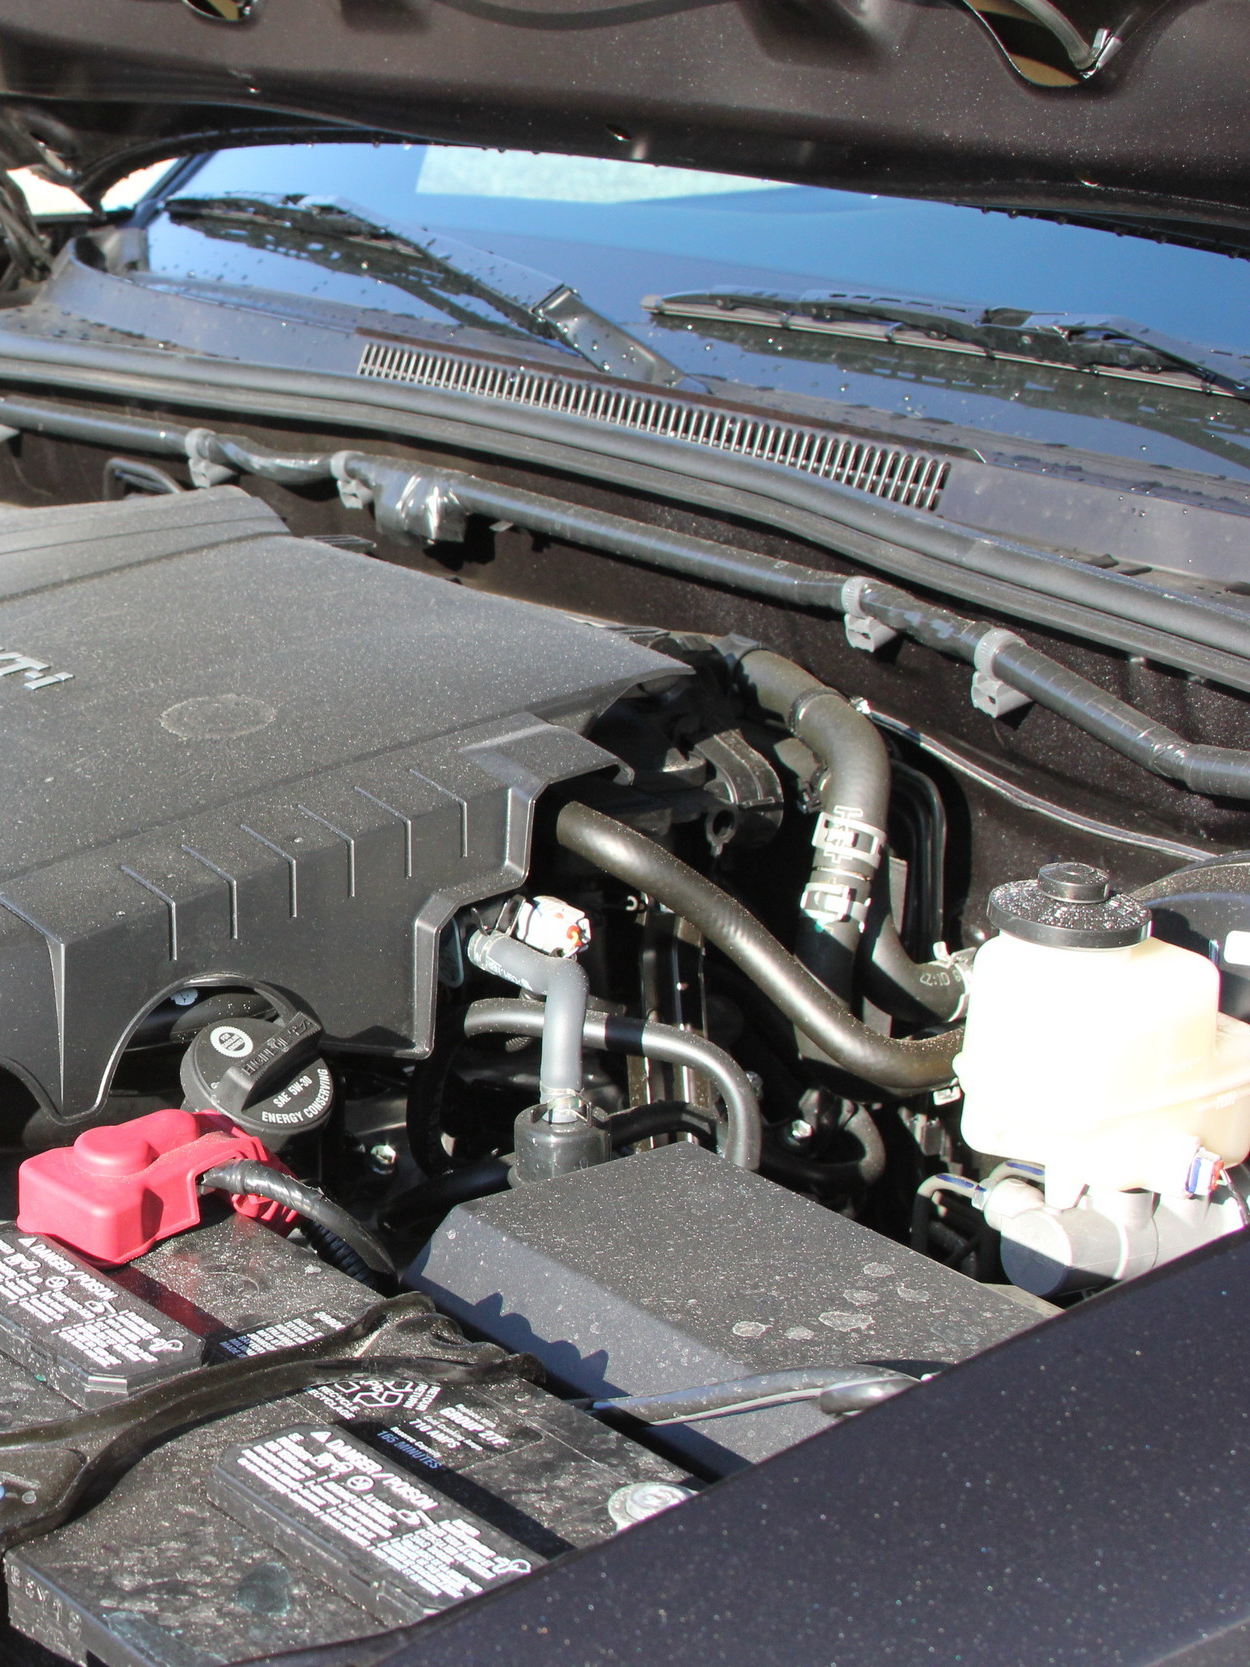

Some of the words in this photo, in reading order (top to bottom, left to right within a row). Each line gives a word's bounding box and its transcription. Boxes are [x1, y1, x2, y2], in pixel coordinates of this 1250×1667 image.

[261, 1111, 304, 1124] ENERGY
[303, 1068, 331, 1118] CONSERVING
[273, 1093, 292, 1108] SAE
[288, 1075, 313, 1096] 5W-30
[302, 1386, 356, 1419] RECYCLAGE
[318, 1385, 361, 1413] RECYCLE
[403, 1383, 429, 1409] RETURN
[415, 1385, 442, 1412] RETOUR
[408, 1418, 430, 1432] 710
[426, 1429, 461, 1449] AMPS
[439, 1407, 485, 1432] GROUP
[377, 1430, 396, 1445] 165
[393, 1438, 442, 1470] MINUTES
